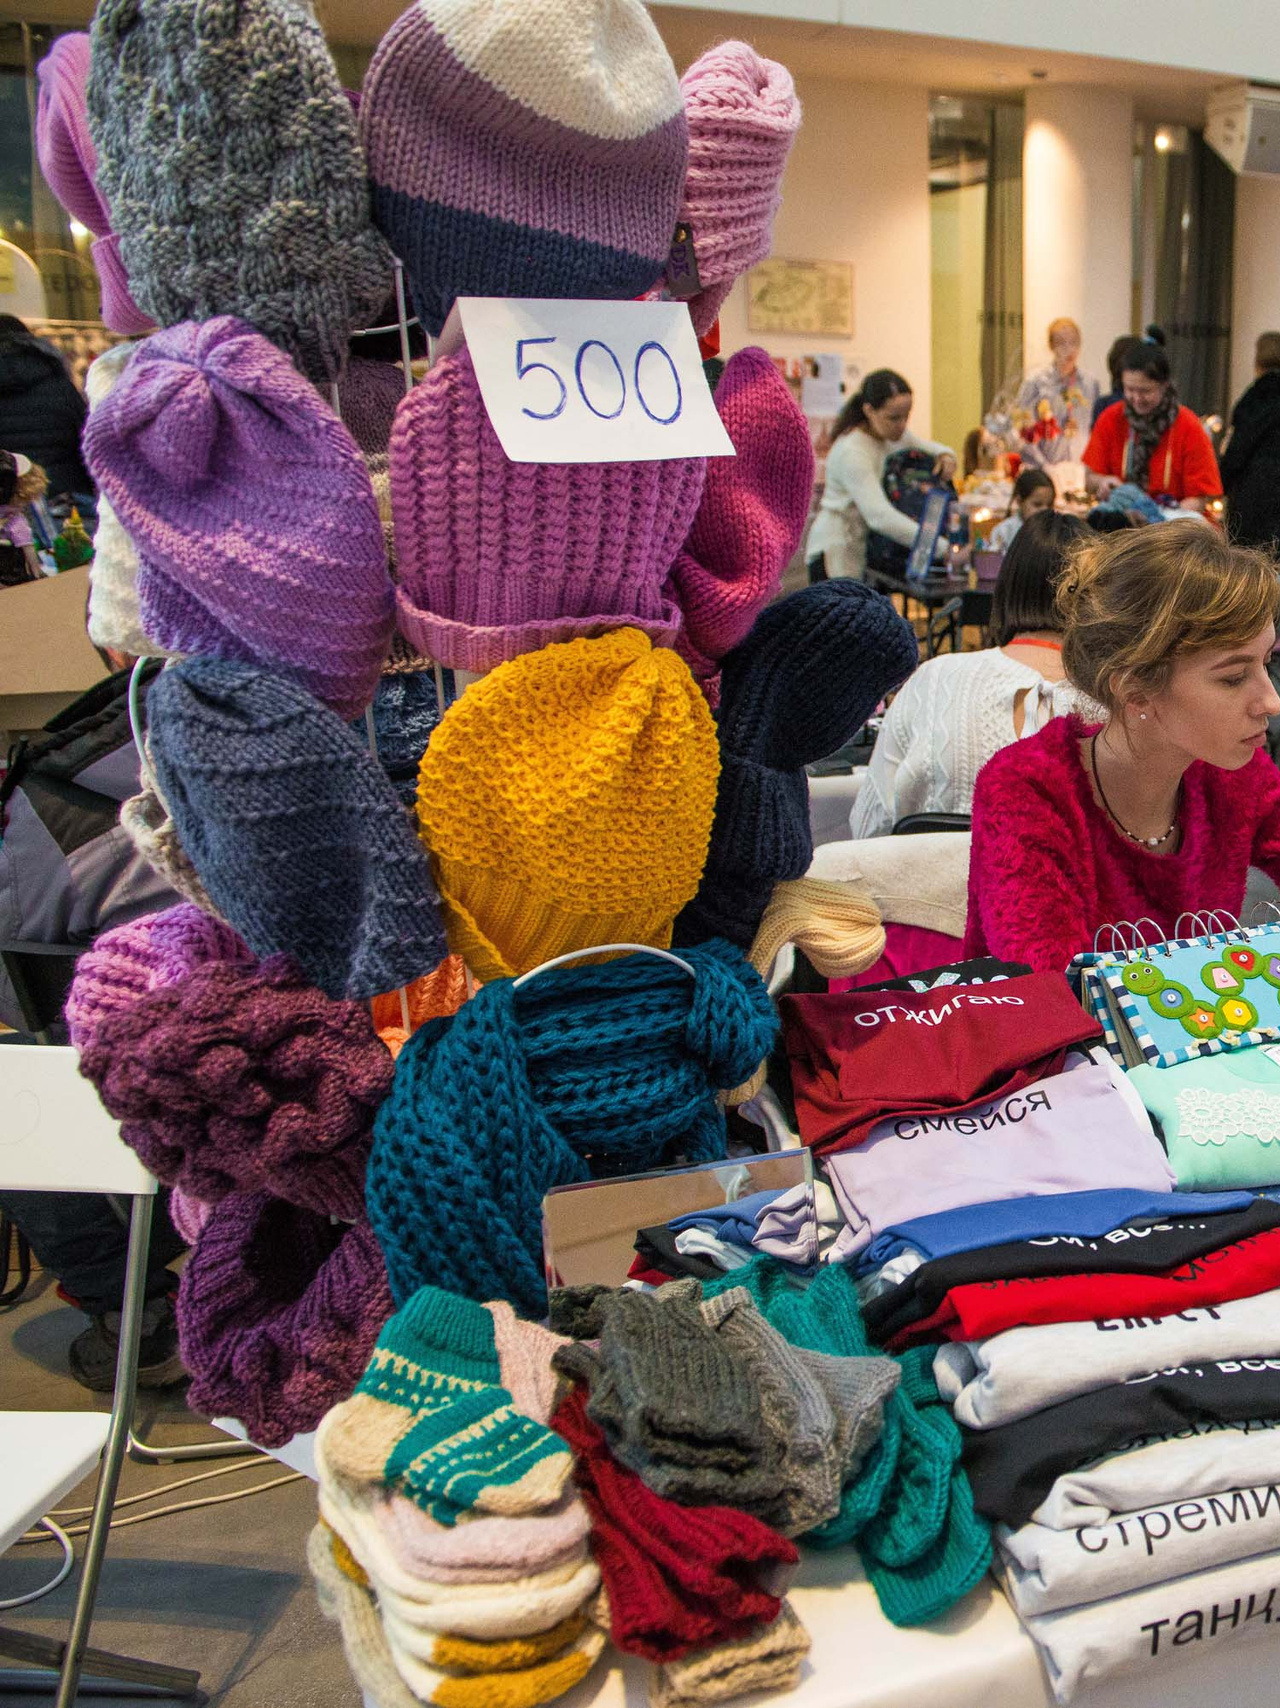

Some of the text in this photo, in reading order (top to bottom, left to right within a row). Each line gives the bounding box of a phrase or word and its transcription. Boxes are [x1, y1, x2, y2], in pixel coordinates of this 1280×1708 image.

[516, 337, 682, 425] 500
[854, 994, 1025, 1026] отжигаю
[894, 1090, 1052, 1141] смейся
